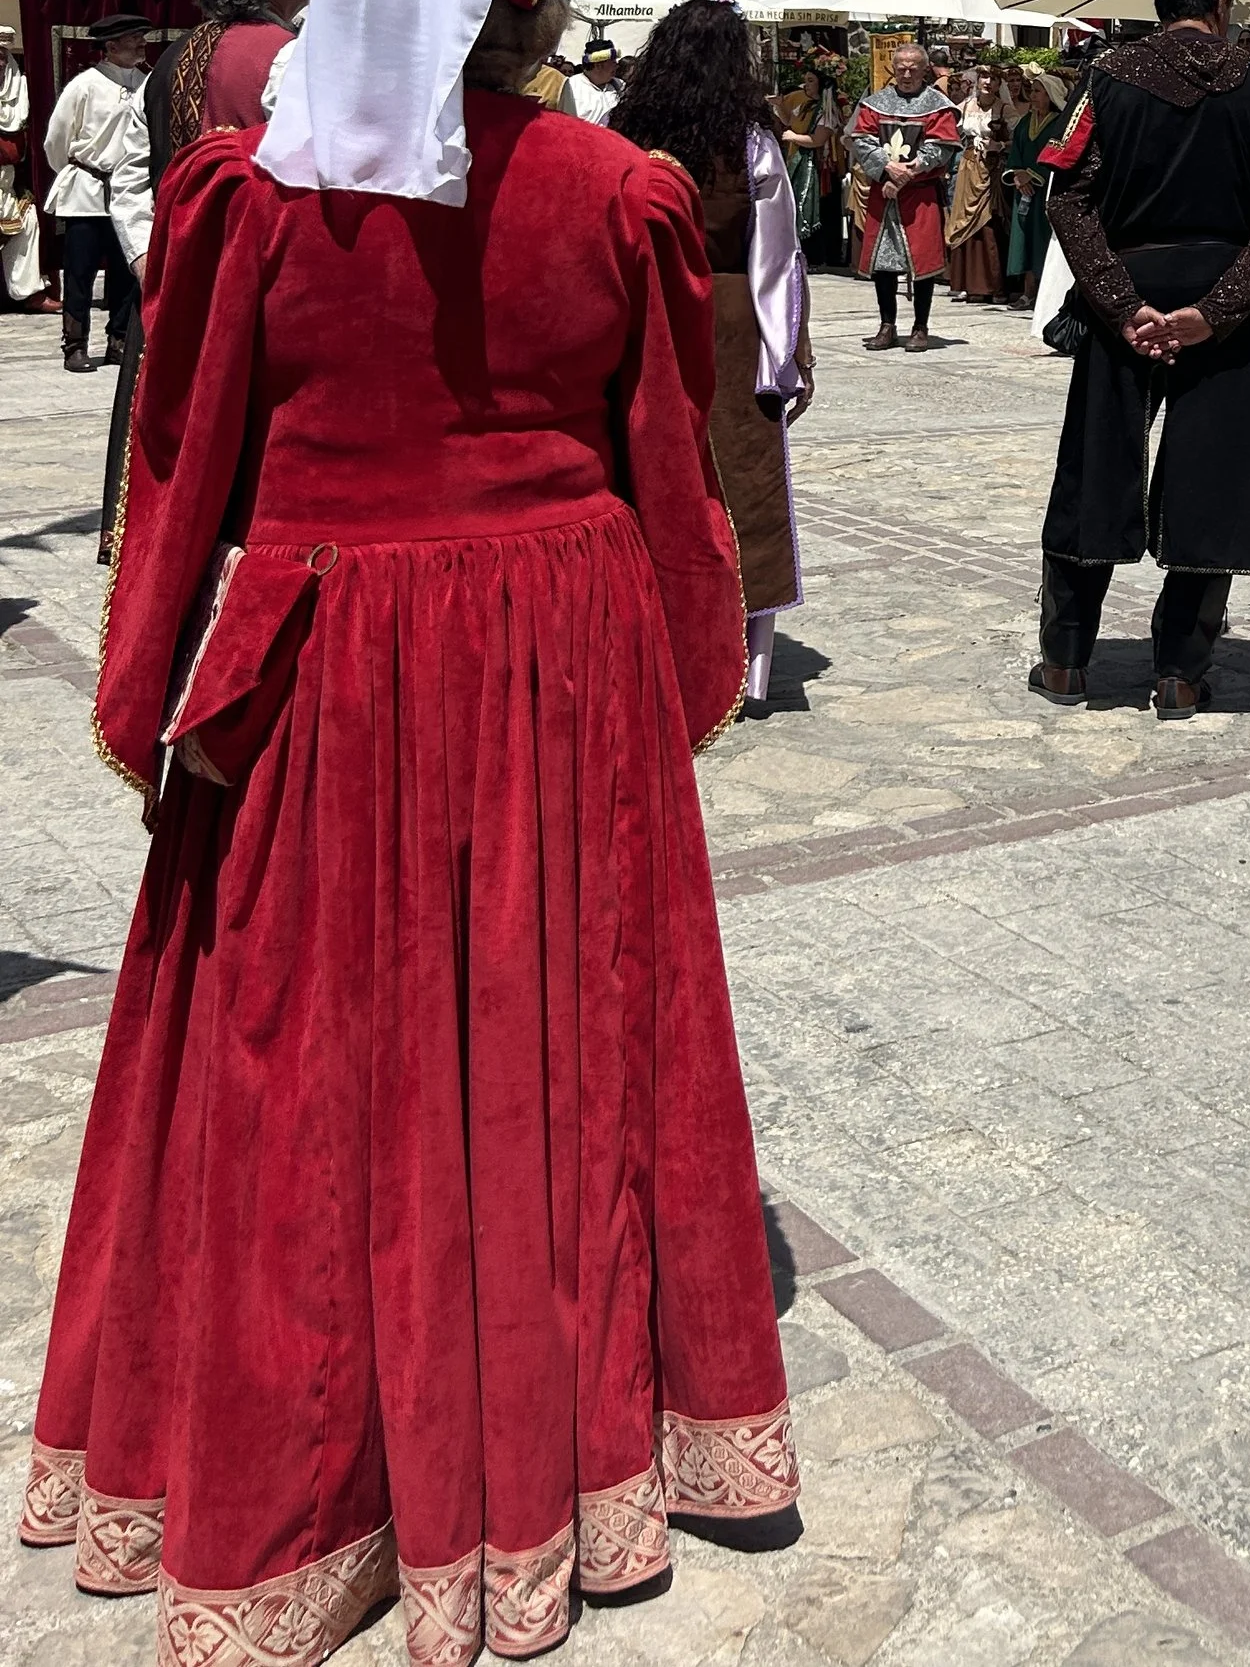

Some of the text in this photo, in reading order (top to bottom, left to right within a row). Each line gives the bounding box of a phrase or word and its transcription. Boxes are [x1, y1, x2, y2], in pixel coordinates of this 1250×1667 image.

[594, 3, 653, 16] Alhambra
[767, 10, 795, 20] HECHA
[797, 11, 812, 21] SIN
[815, 12, 839, 23] PRISA
